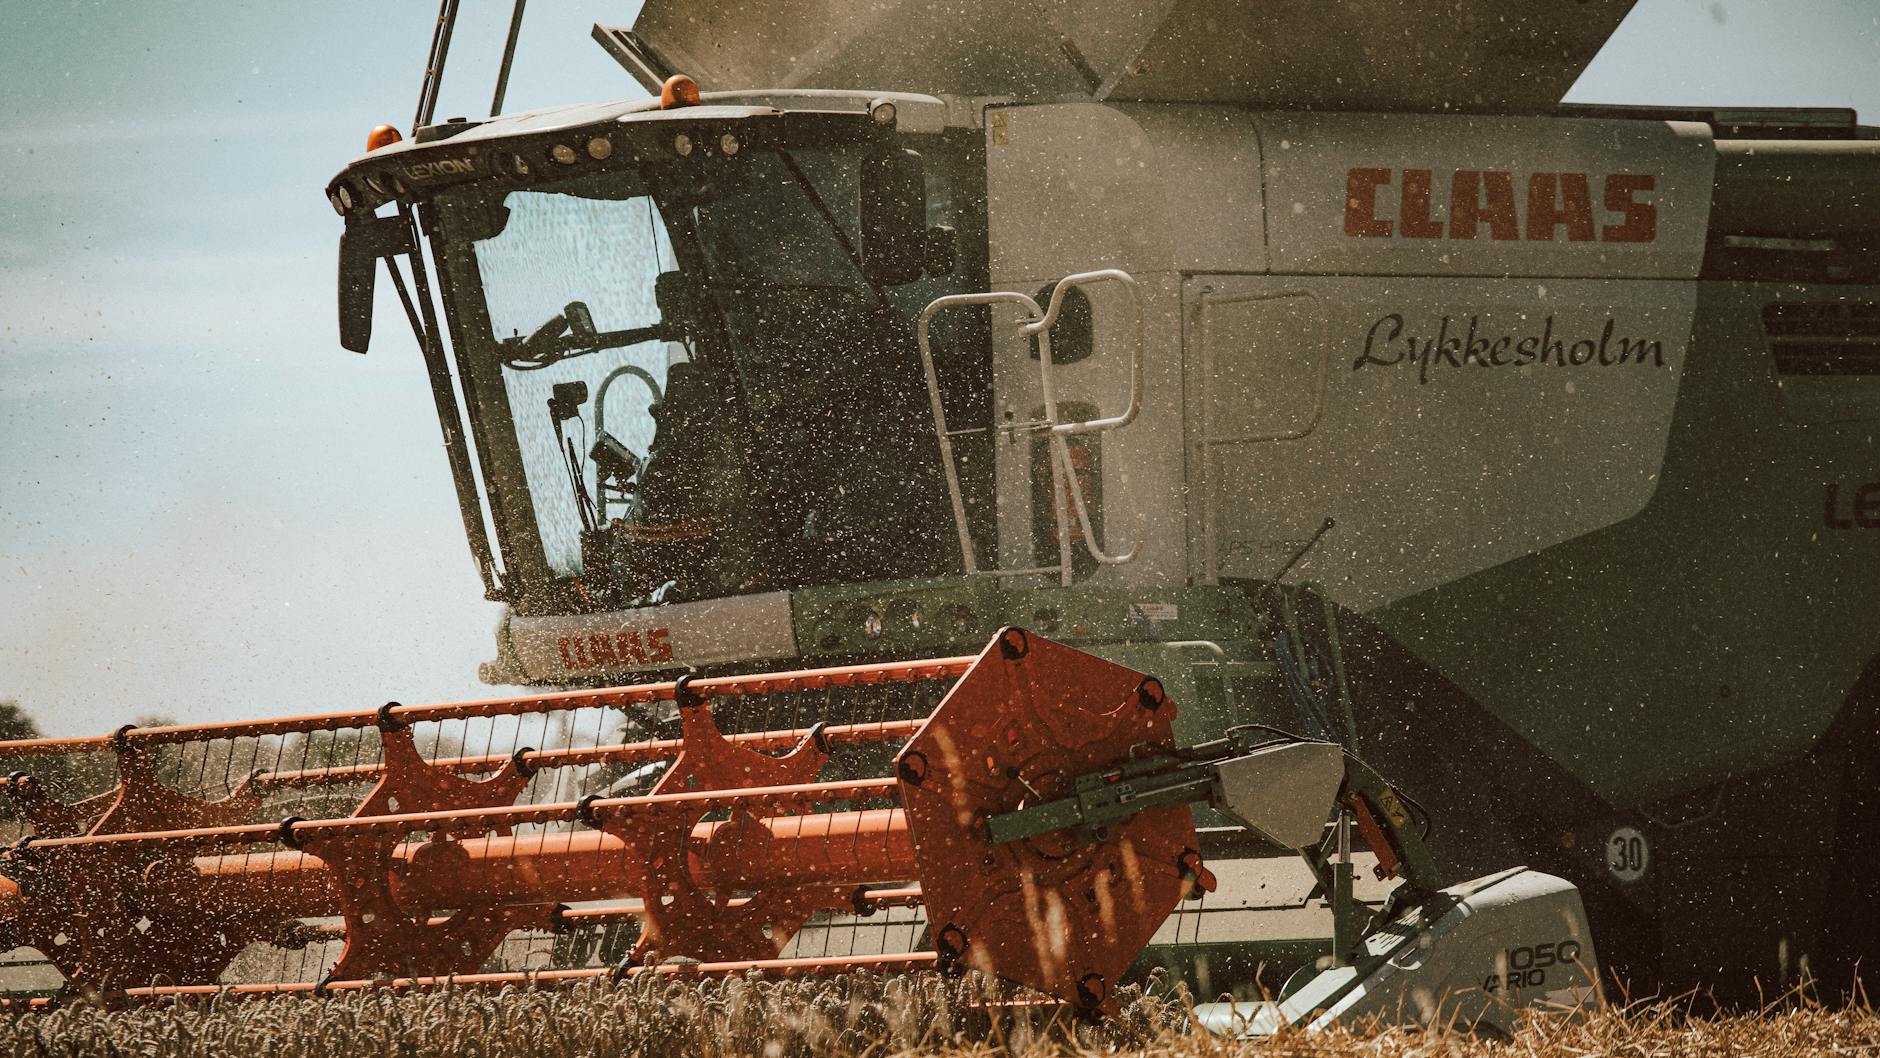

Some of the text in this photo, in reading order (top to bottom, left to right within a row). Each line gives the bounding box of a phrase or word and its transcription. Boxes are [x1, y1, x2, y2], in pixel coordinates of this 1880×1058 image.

[403, 158, 475, 180] LEXION
[1344, 167, 1657, 243] CLAAS
[1353, 313, 1665, 385] Lykkesholm
[557, 628, 674, 669] CLAAS
[1612, 836, 1641, 871] 30
